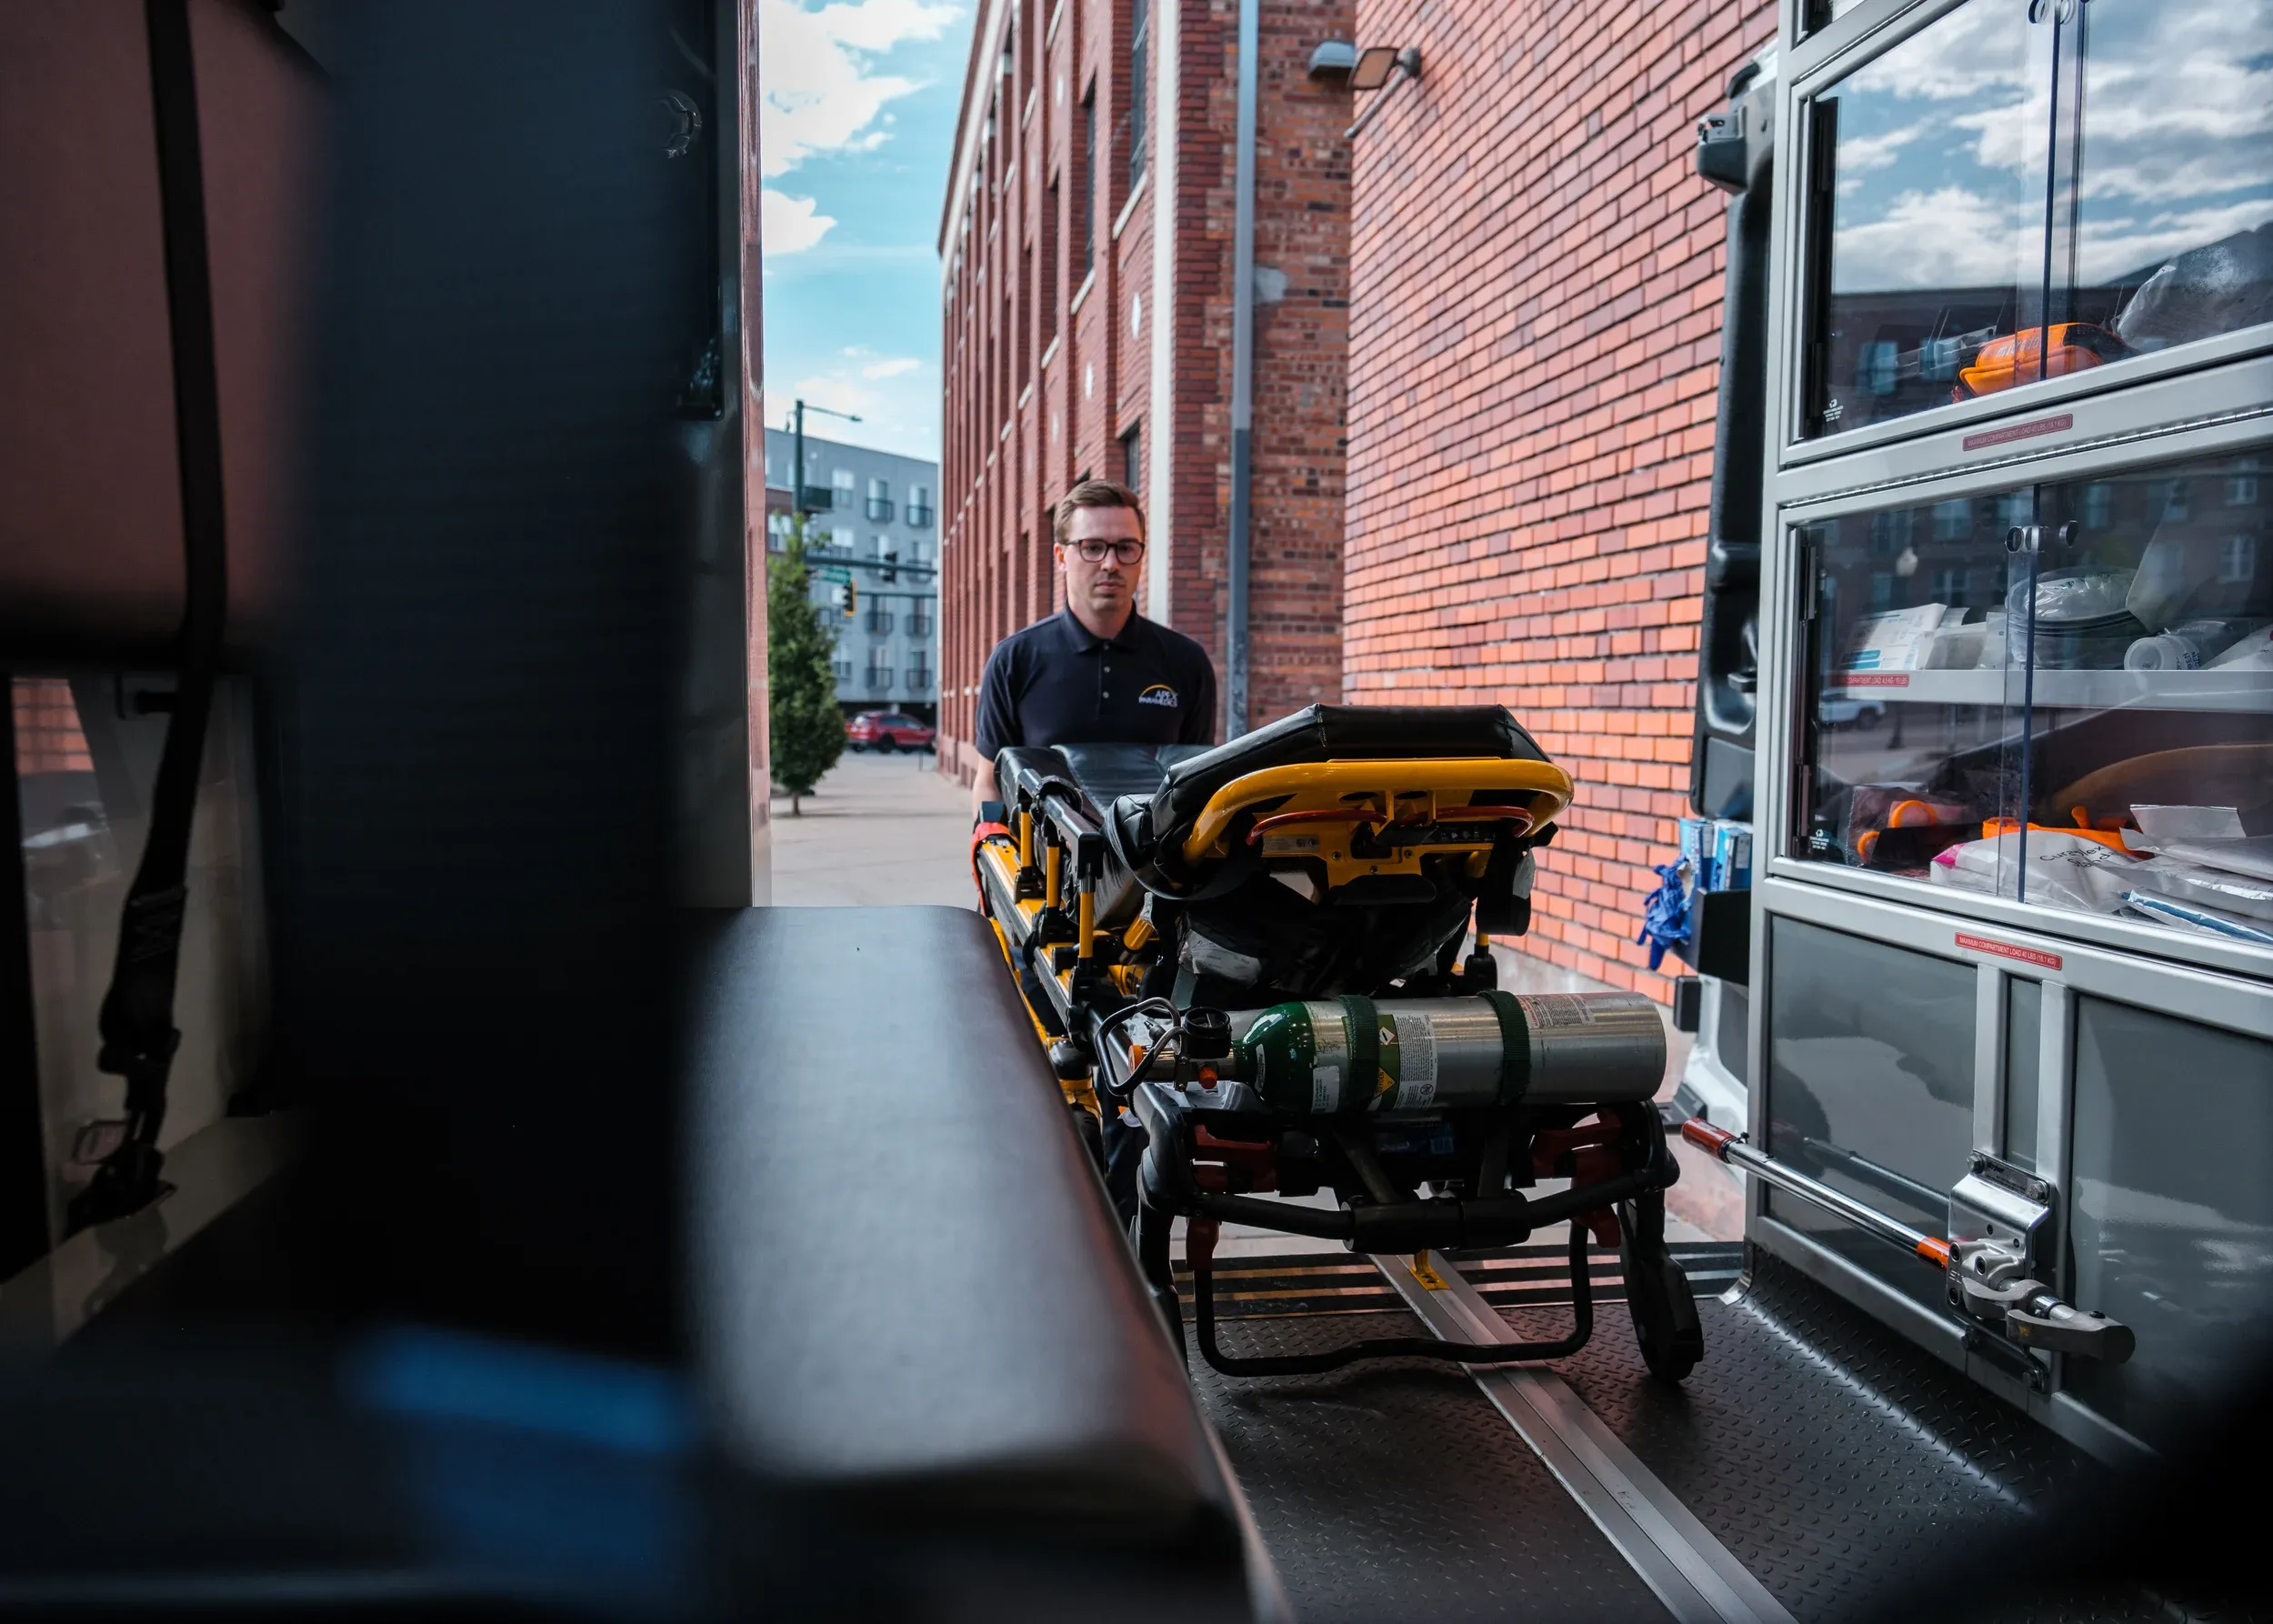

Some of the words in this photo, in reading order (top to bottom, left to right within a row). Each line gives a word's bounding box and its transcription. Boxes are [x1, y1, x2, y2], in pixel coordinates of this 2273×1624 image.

[1968, 437, 1988, 446] MAXIMUM
[1988, 430, 2018, 443] COMPARTMENT
[2018, 426, 2031, 436] LOAD
[2038, 424, 2046, 432] LBS
[1155, 689, 1178, 700] APEX
[1959, 937, 1978, 947] MAXIMUM
[1978, 941, 2009, 954] COMPARTMENT
[2009, 947, 2021, 957] LOAD
[2028, 952, 2037, 960] LBS
[2037, 954, 2047, 964] (18.1
[2047, 956, 2056, 967] KG)
